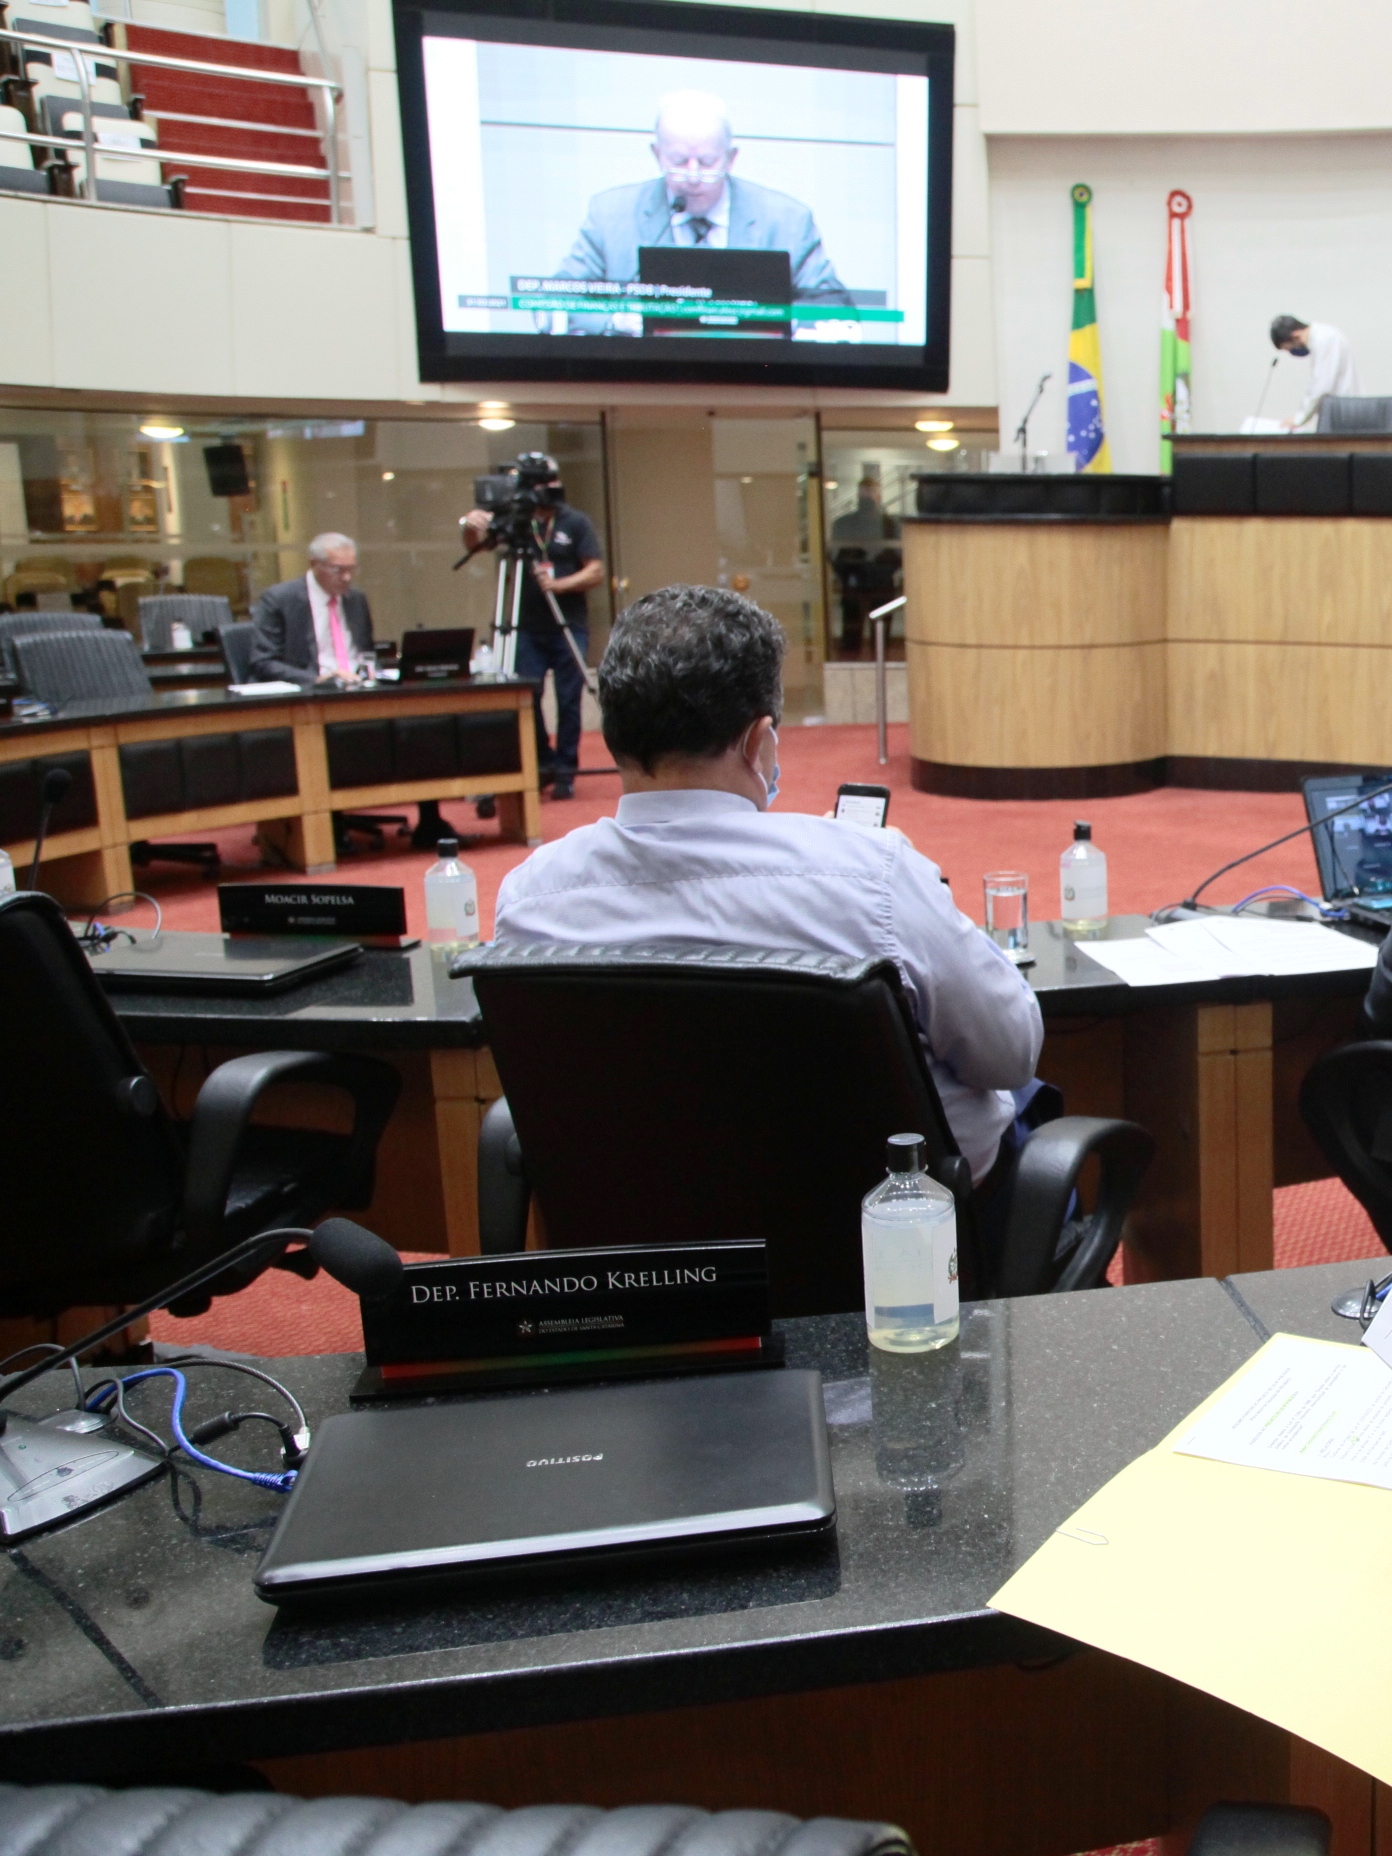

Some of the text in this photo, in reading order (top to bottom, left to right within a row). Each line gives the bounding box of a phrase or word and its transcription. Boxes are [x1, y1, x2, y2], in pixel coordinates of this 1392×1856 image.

[265, 894, 355, 905] MOACIR SOPELSA
[469, 1274, 598, 1302] FERNANDO
[607, 1265, 718, 1292] KRELLING
[581, 1314, 624, 1324] LEGISLATIVA
[526, 1452, 604, 1468] POSITIVO
